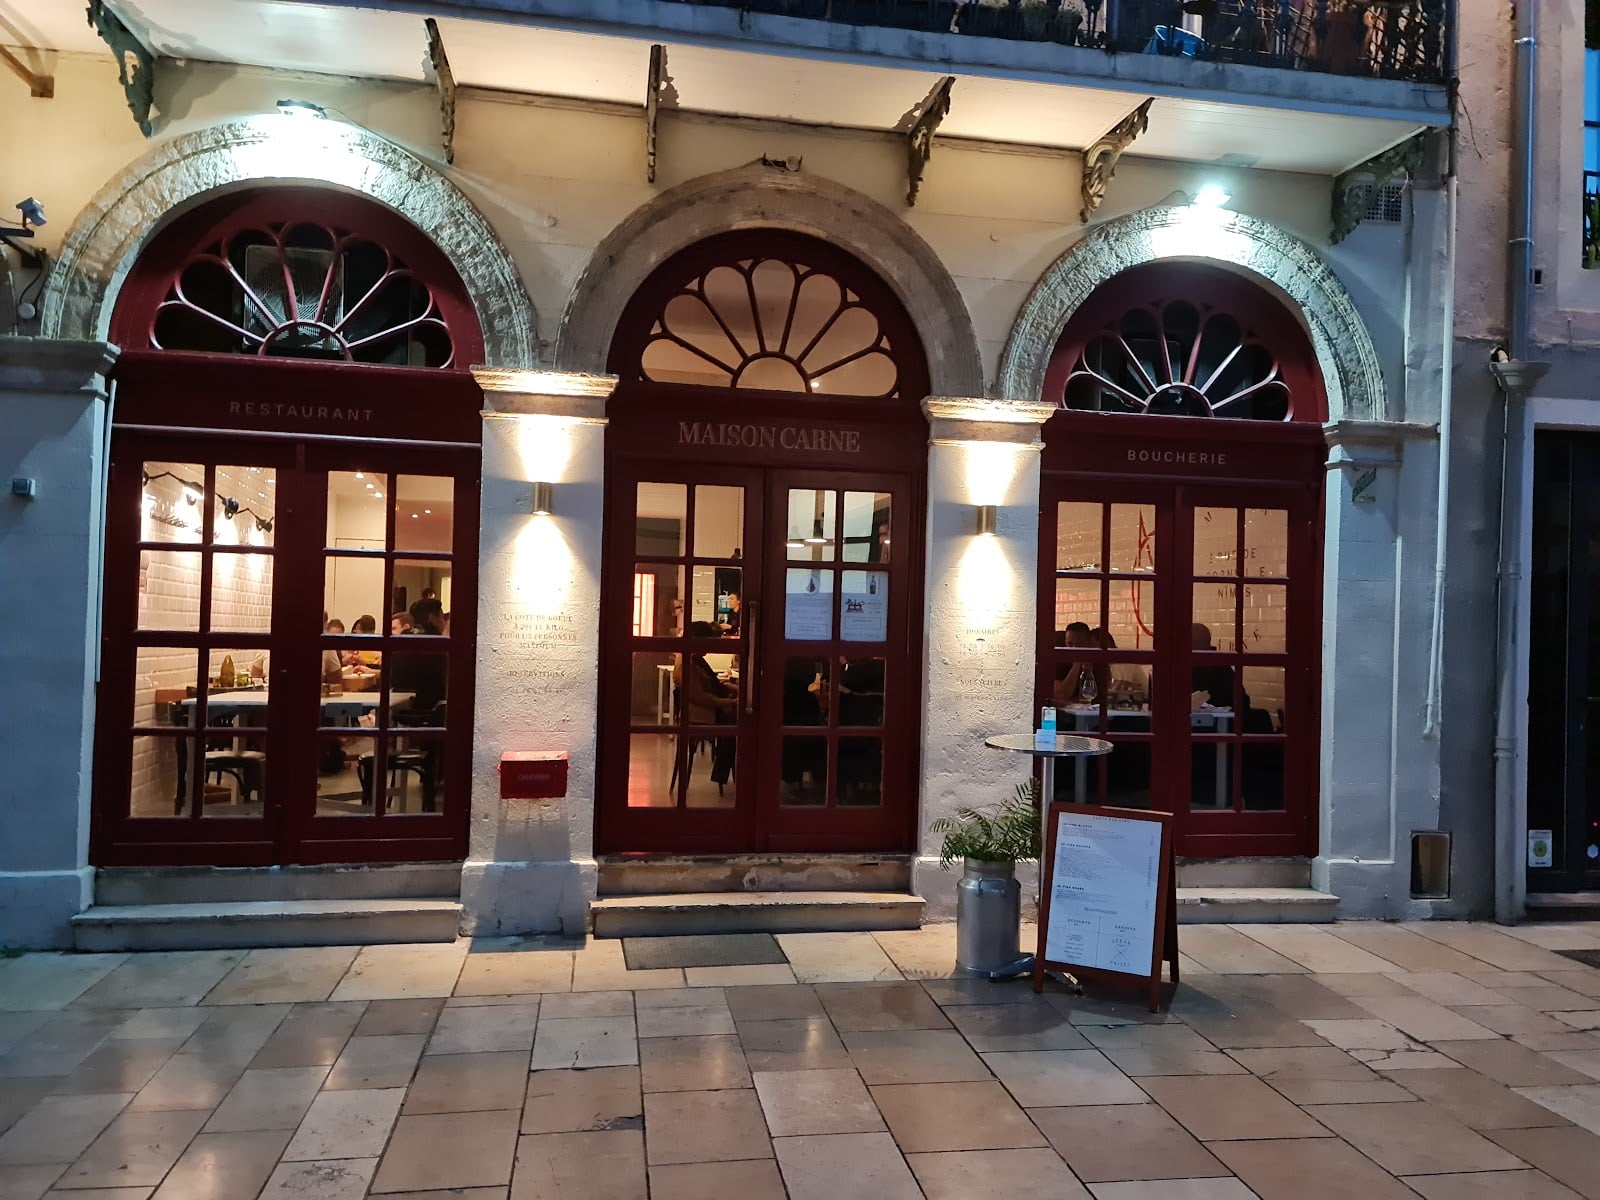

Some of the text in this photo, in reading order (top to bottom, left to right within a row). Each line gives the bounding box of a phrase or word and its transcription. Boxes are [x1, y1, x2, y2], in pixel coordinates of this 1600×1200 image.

[230, 401, 373, 421] RESTAURANT
[679, 422, 860, 452] MAISON CARNE
[1127, 449, 1226, 465] BOUCHERIE
